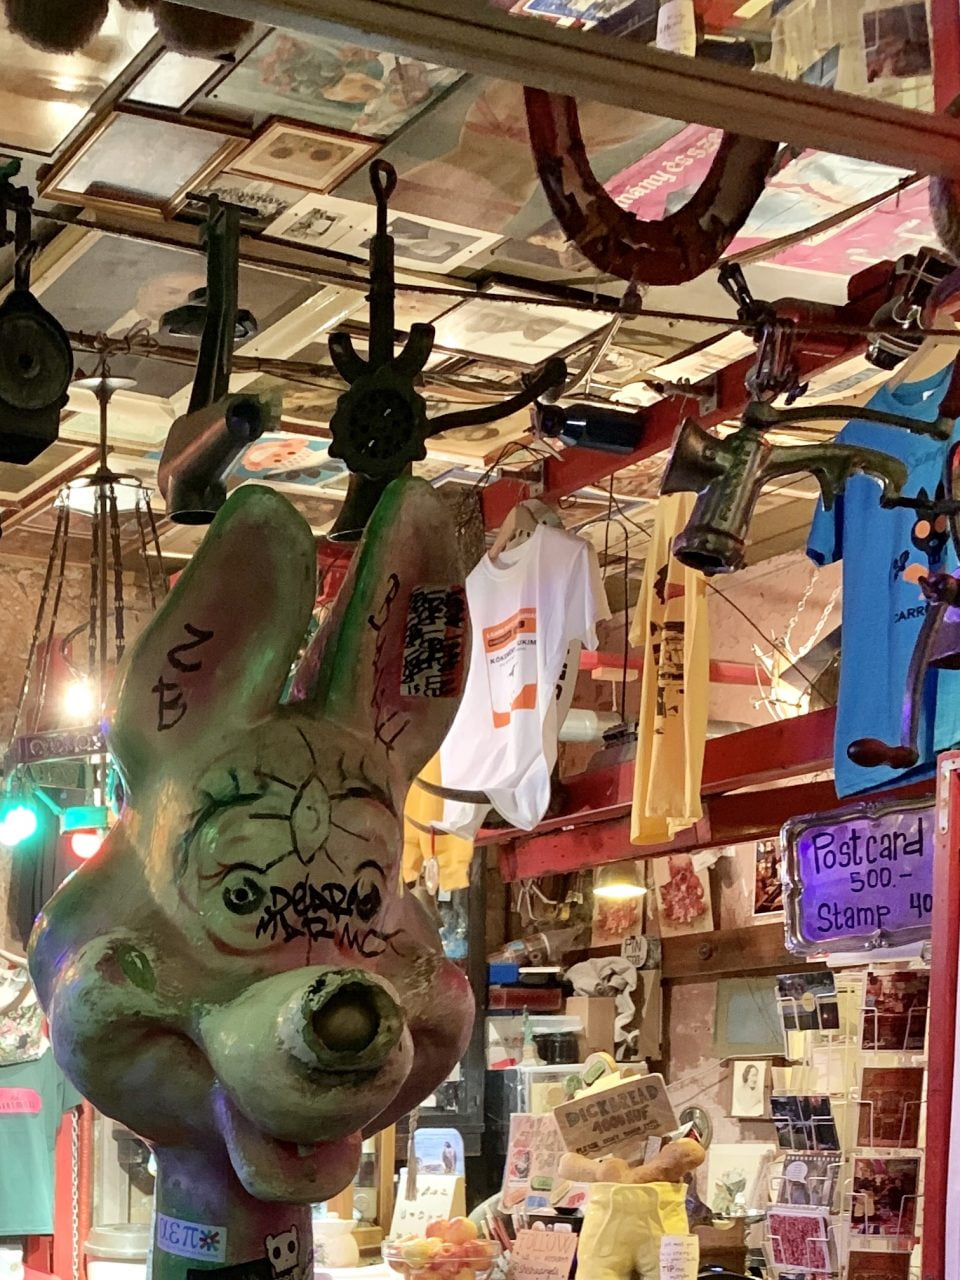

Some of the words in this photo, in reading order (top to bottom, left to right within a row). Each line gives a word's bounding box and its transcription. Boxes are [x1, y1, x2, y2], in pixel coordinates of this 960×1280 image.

[811, 817, 924, 874] Postcard
[817, 902, 891, 932] Stamp
[565, 1085, 659, 1128] DICKBREAD
